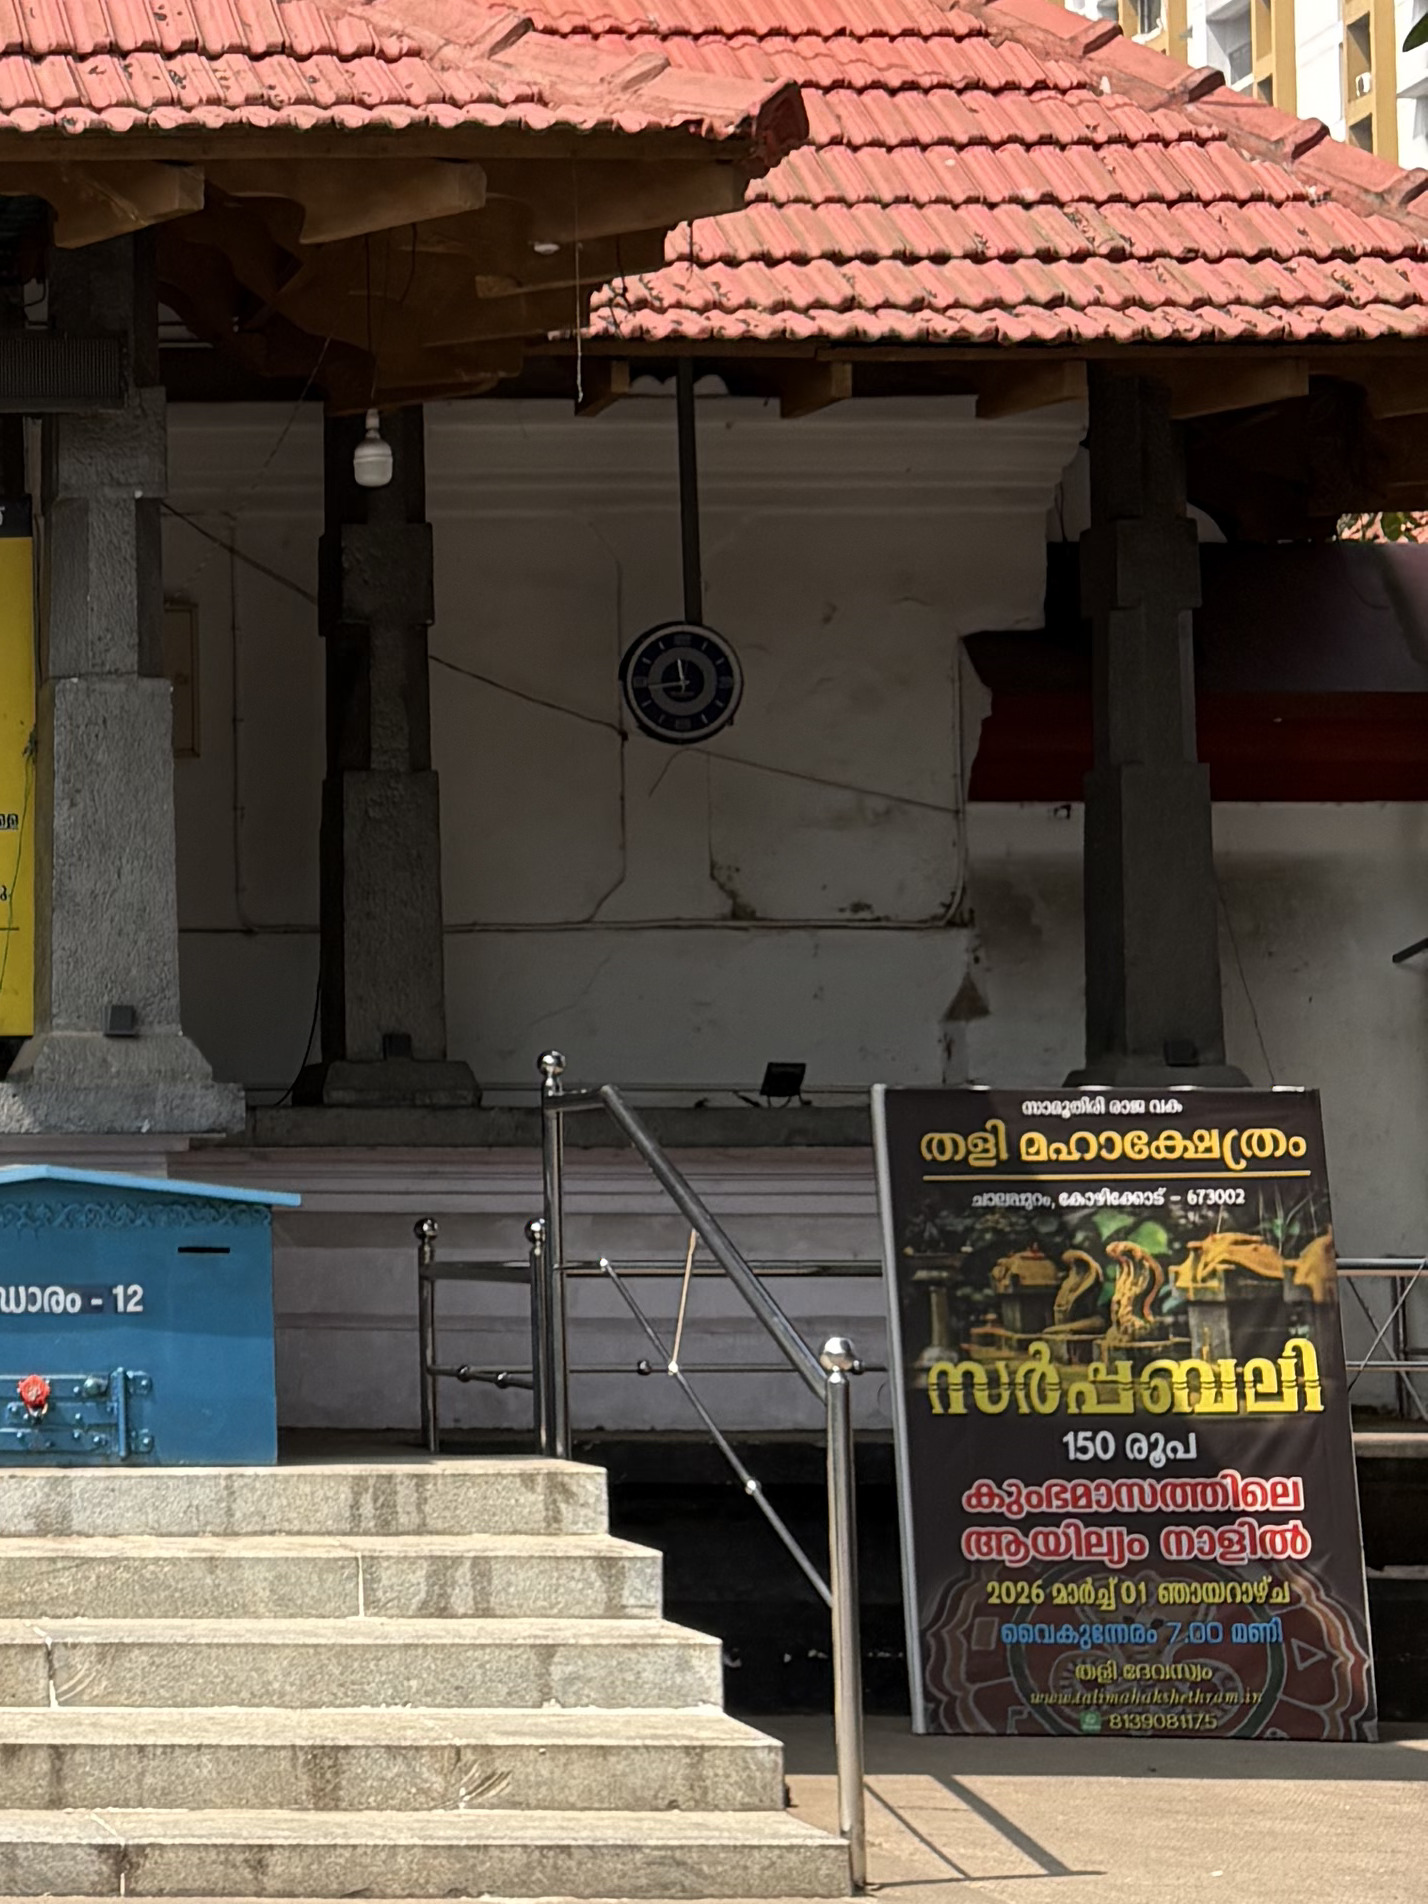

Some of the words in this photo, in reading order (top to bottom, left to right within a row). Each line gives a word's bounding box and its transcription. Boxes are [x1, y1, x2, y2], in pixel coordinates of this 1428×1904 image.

[920, 1118, 1007, 1169] തളി
[1018, 1126, 1308, 1171] മഹാക്ഷേത്രം
[1186, 1187, 1247, 1206] 673002
[112, 1283, 144, 1314] 12
[926, 1337, 1325, 1417] സർപ്പബലി
[1062, 1430, 1120, 1462] 150
[1125, 1431, 1198, 1469] രൂപ
[961, 1469, 1306, 1516] കുംഭമാസത്തിലെ
[960, 1520, 1149, 1568] ആയില്യം
[1159, 1520, 1312, 1566] നാളിൽ
[986, 1580, 1045, 1606] 2026
[1051, 1576, 1118, 1612] മാർച്ച്
[1121, 1581, 1147, 1606] 01
[1157, 1575, 1292, 1605] ഞായറാഴ്ച
[1001, 1621, 1158, 1652] വൈകുന്നേരം
[1166, 1621, 1224, 1645] 7.00
[1231, 1616, 1284, 1645] മണി
[1074, 1660, 1118, 1684] തളി
[1122, 1662, 1214, 1683] ദേവസ്വം
[1107, 1712, 1219, 1731] 8139081175
